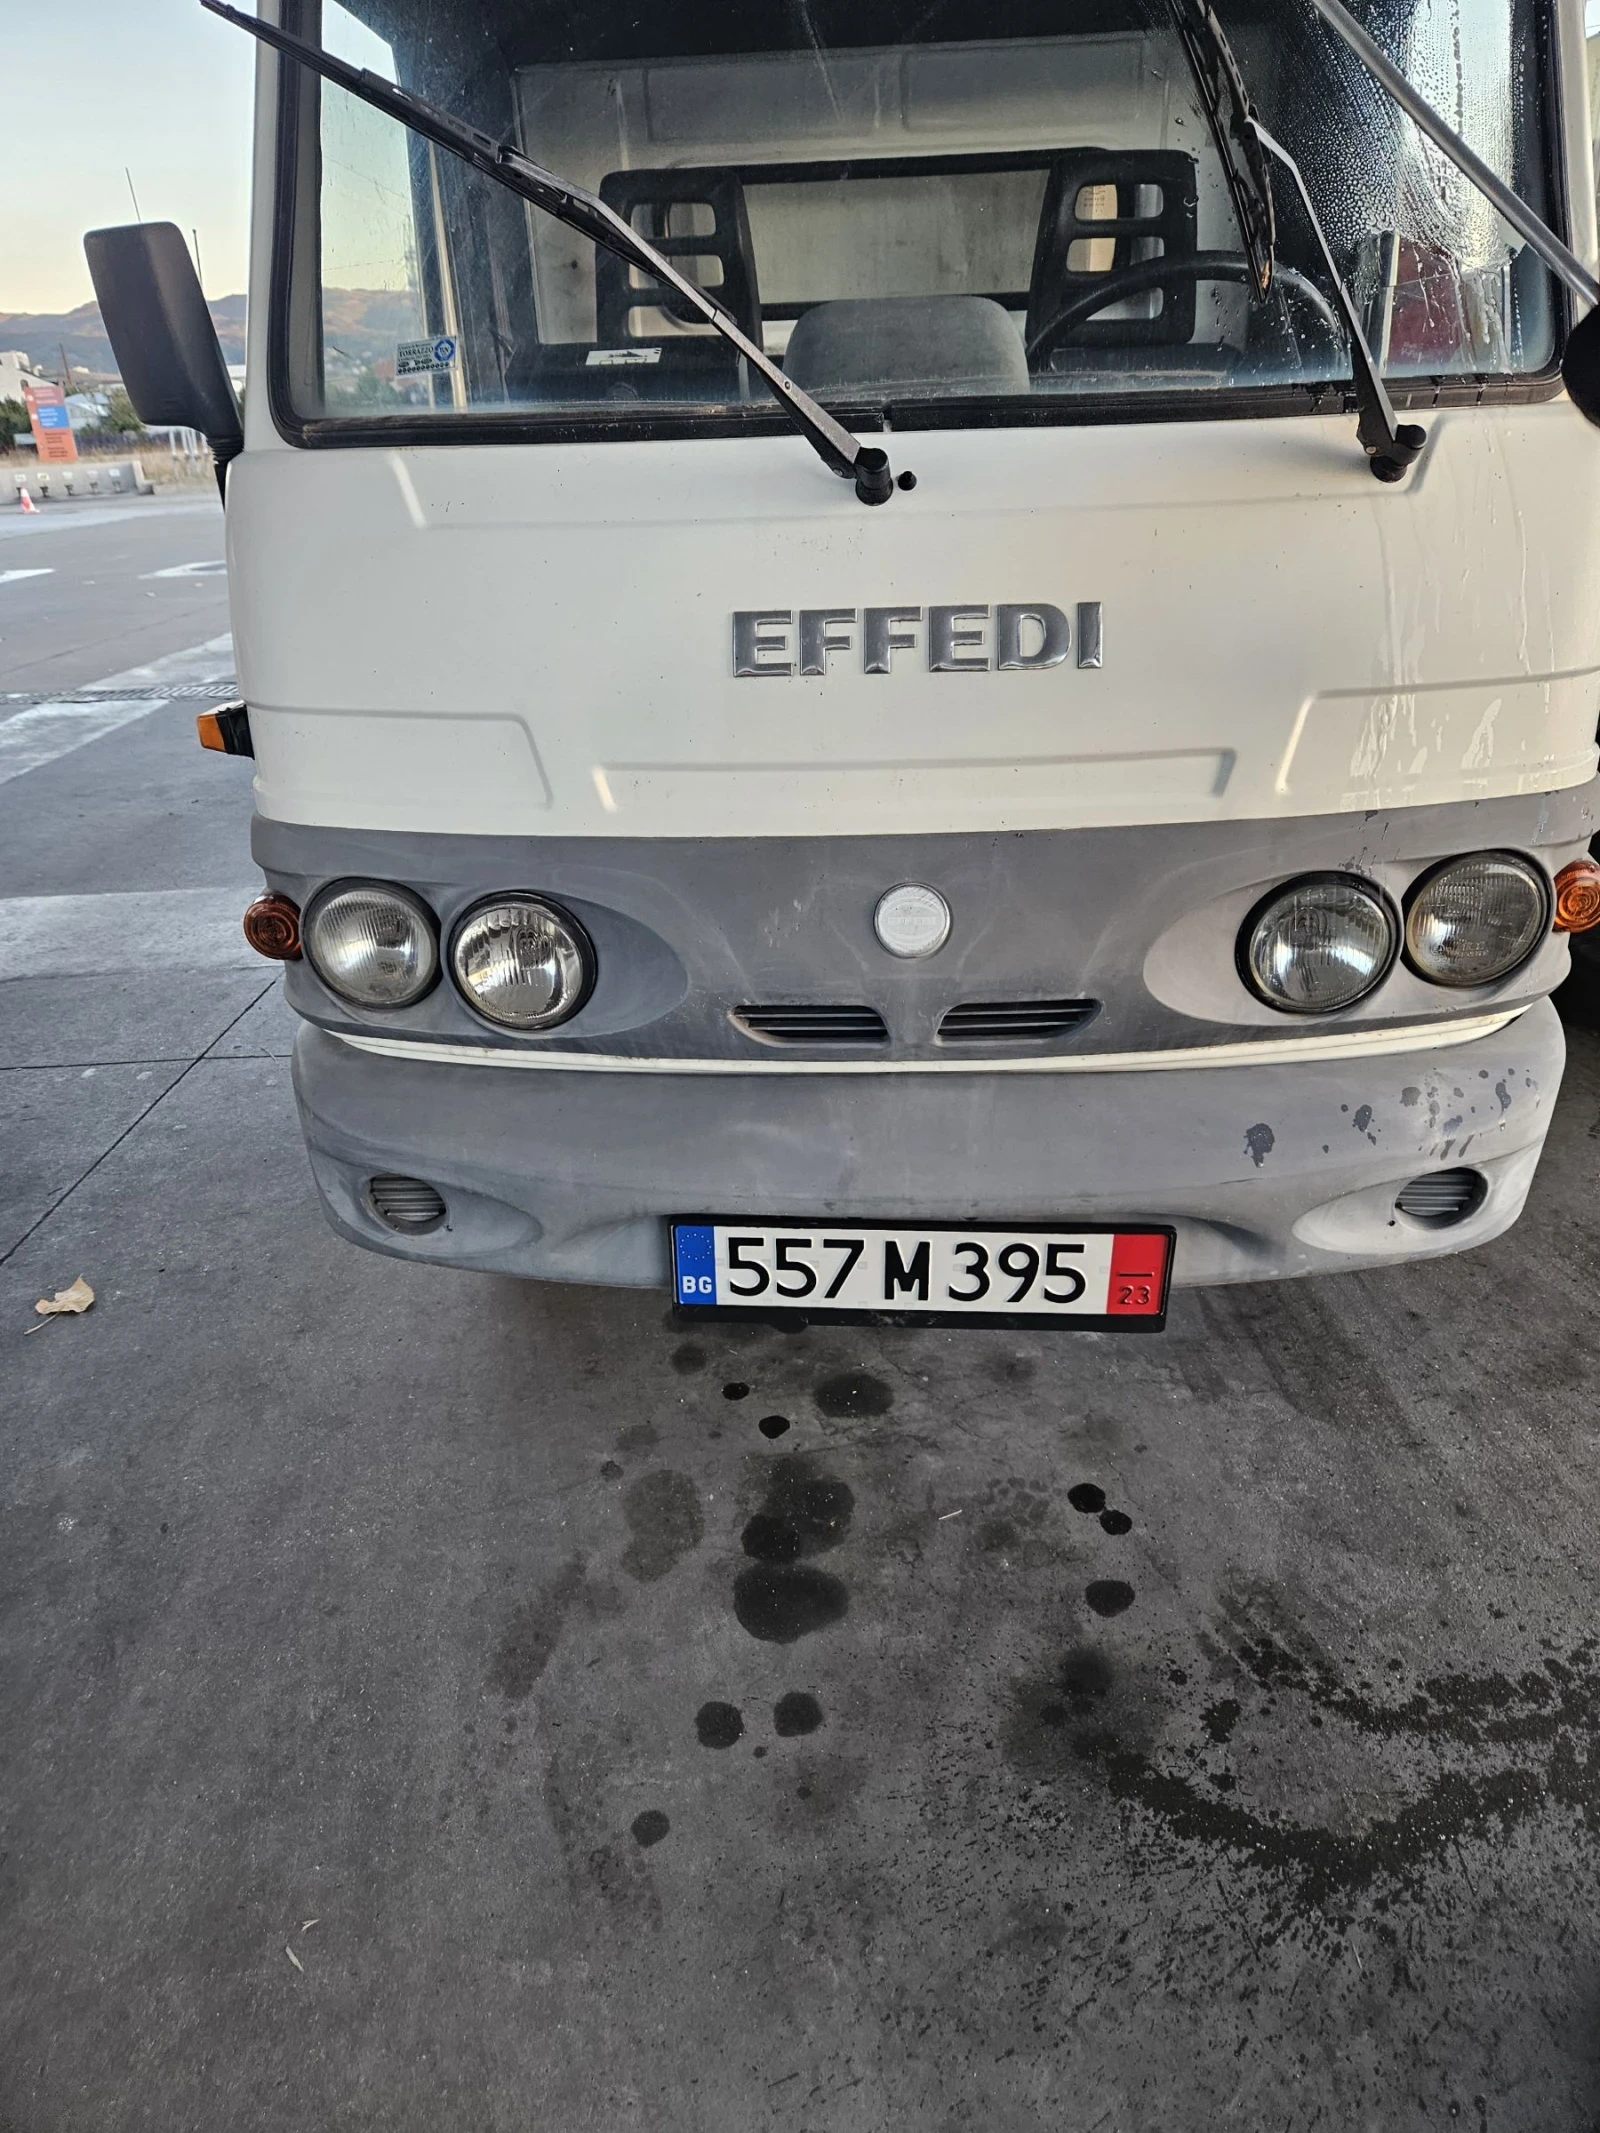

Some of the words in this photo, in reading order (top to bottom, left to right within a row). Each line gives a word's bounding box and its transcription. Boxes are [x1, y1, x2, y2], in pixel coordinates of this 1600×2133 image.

[733, 602, 1103, 677] EFFEDI
[682, 1275, 712, 1294] BG
[728, 1237, 865, 1299] 557
[884, 1241, 931, 1301] M
[948, 1242, 1087, 1304] 395
[1118, 1285, 1151, 1305] 23
